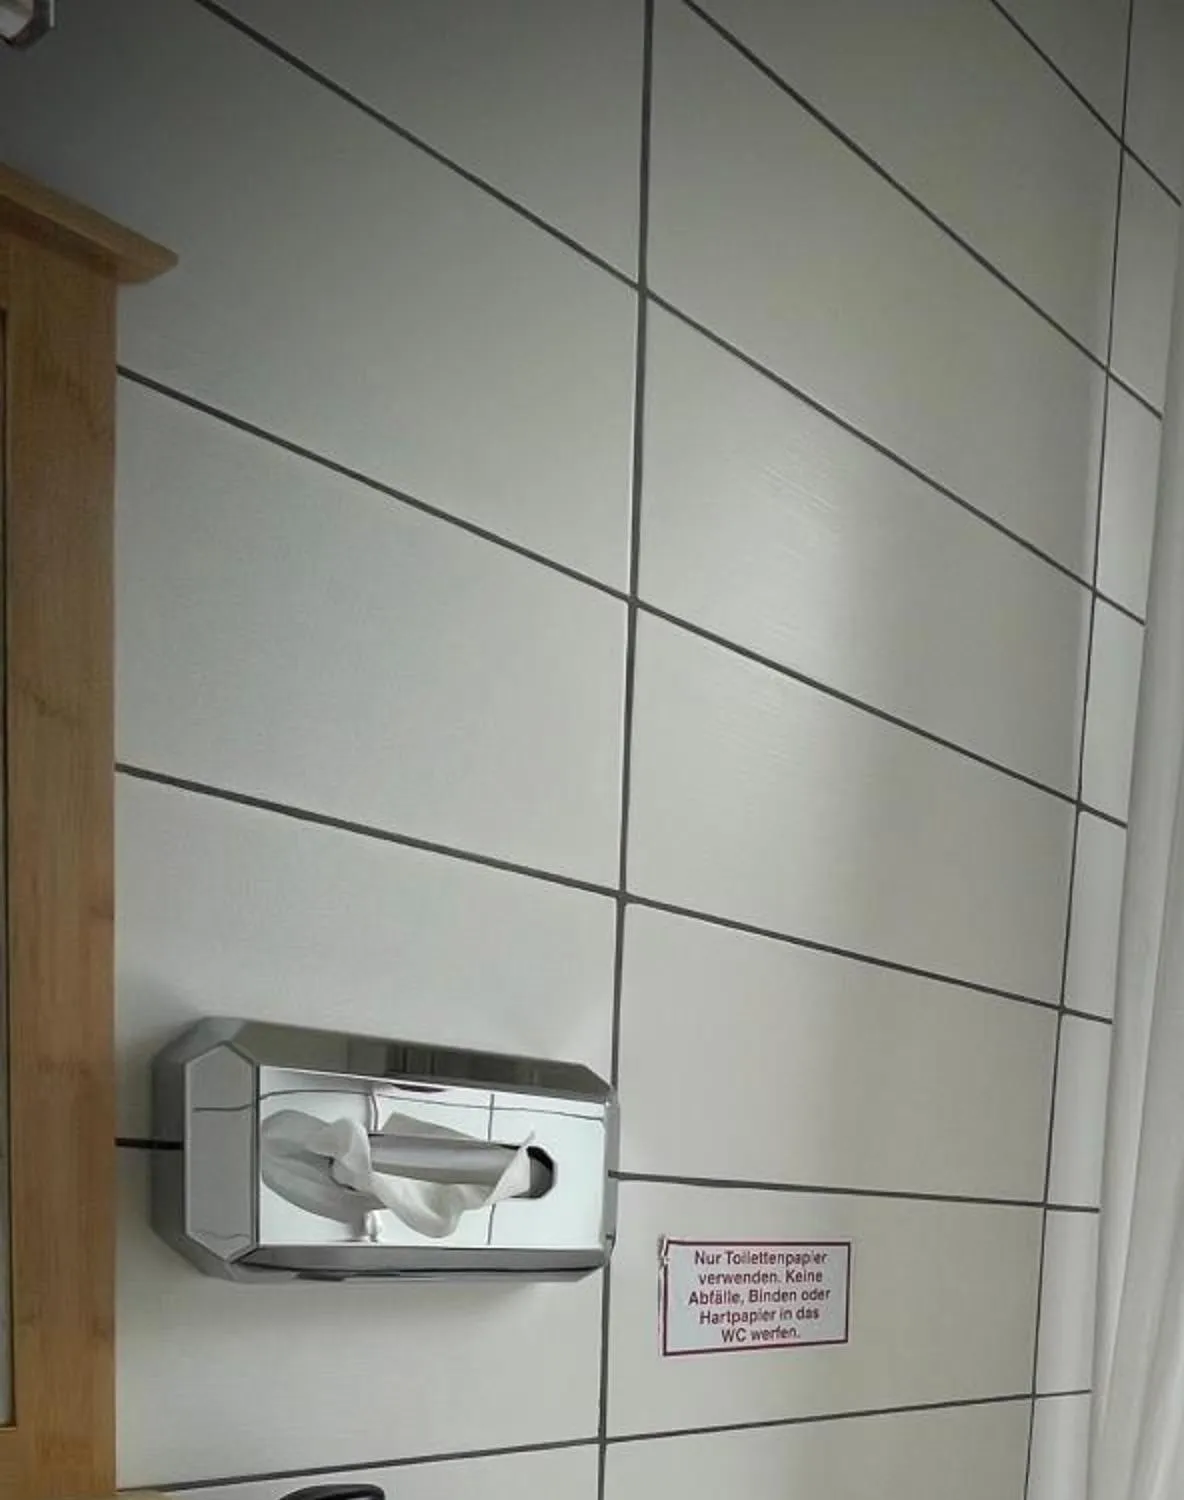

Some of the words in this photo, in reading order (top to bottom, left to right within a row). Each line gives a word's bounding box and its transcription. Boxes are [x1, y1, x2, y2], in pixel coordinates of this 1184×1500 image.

[694, 1250, 721, 1265] Nur
[698, 1271, 782, 1285] verwenden.
[785, 1270, 823, 1283] Keine
[748, 1289, 797, 1303] Binden
[801, 1288, 831, 1302] oder
[699, 1310, 777, 1326] Hartpapier
[779, 1308, 793, 1321] in
[796, 1307, 820, 1320] das
[721, 1328, 747, 1343] WC
[751, 1326, 801, 1341] werfen.
